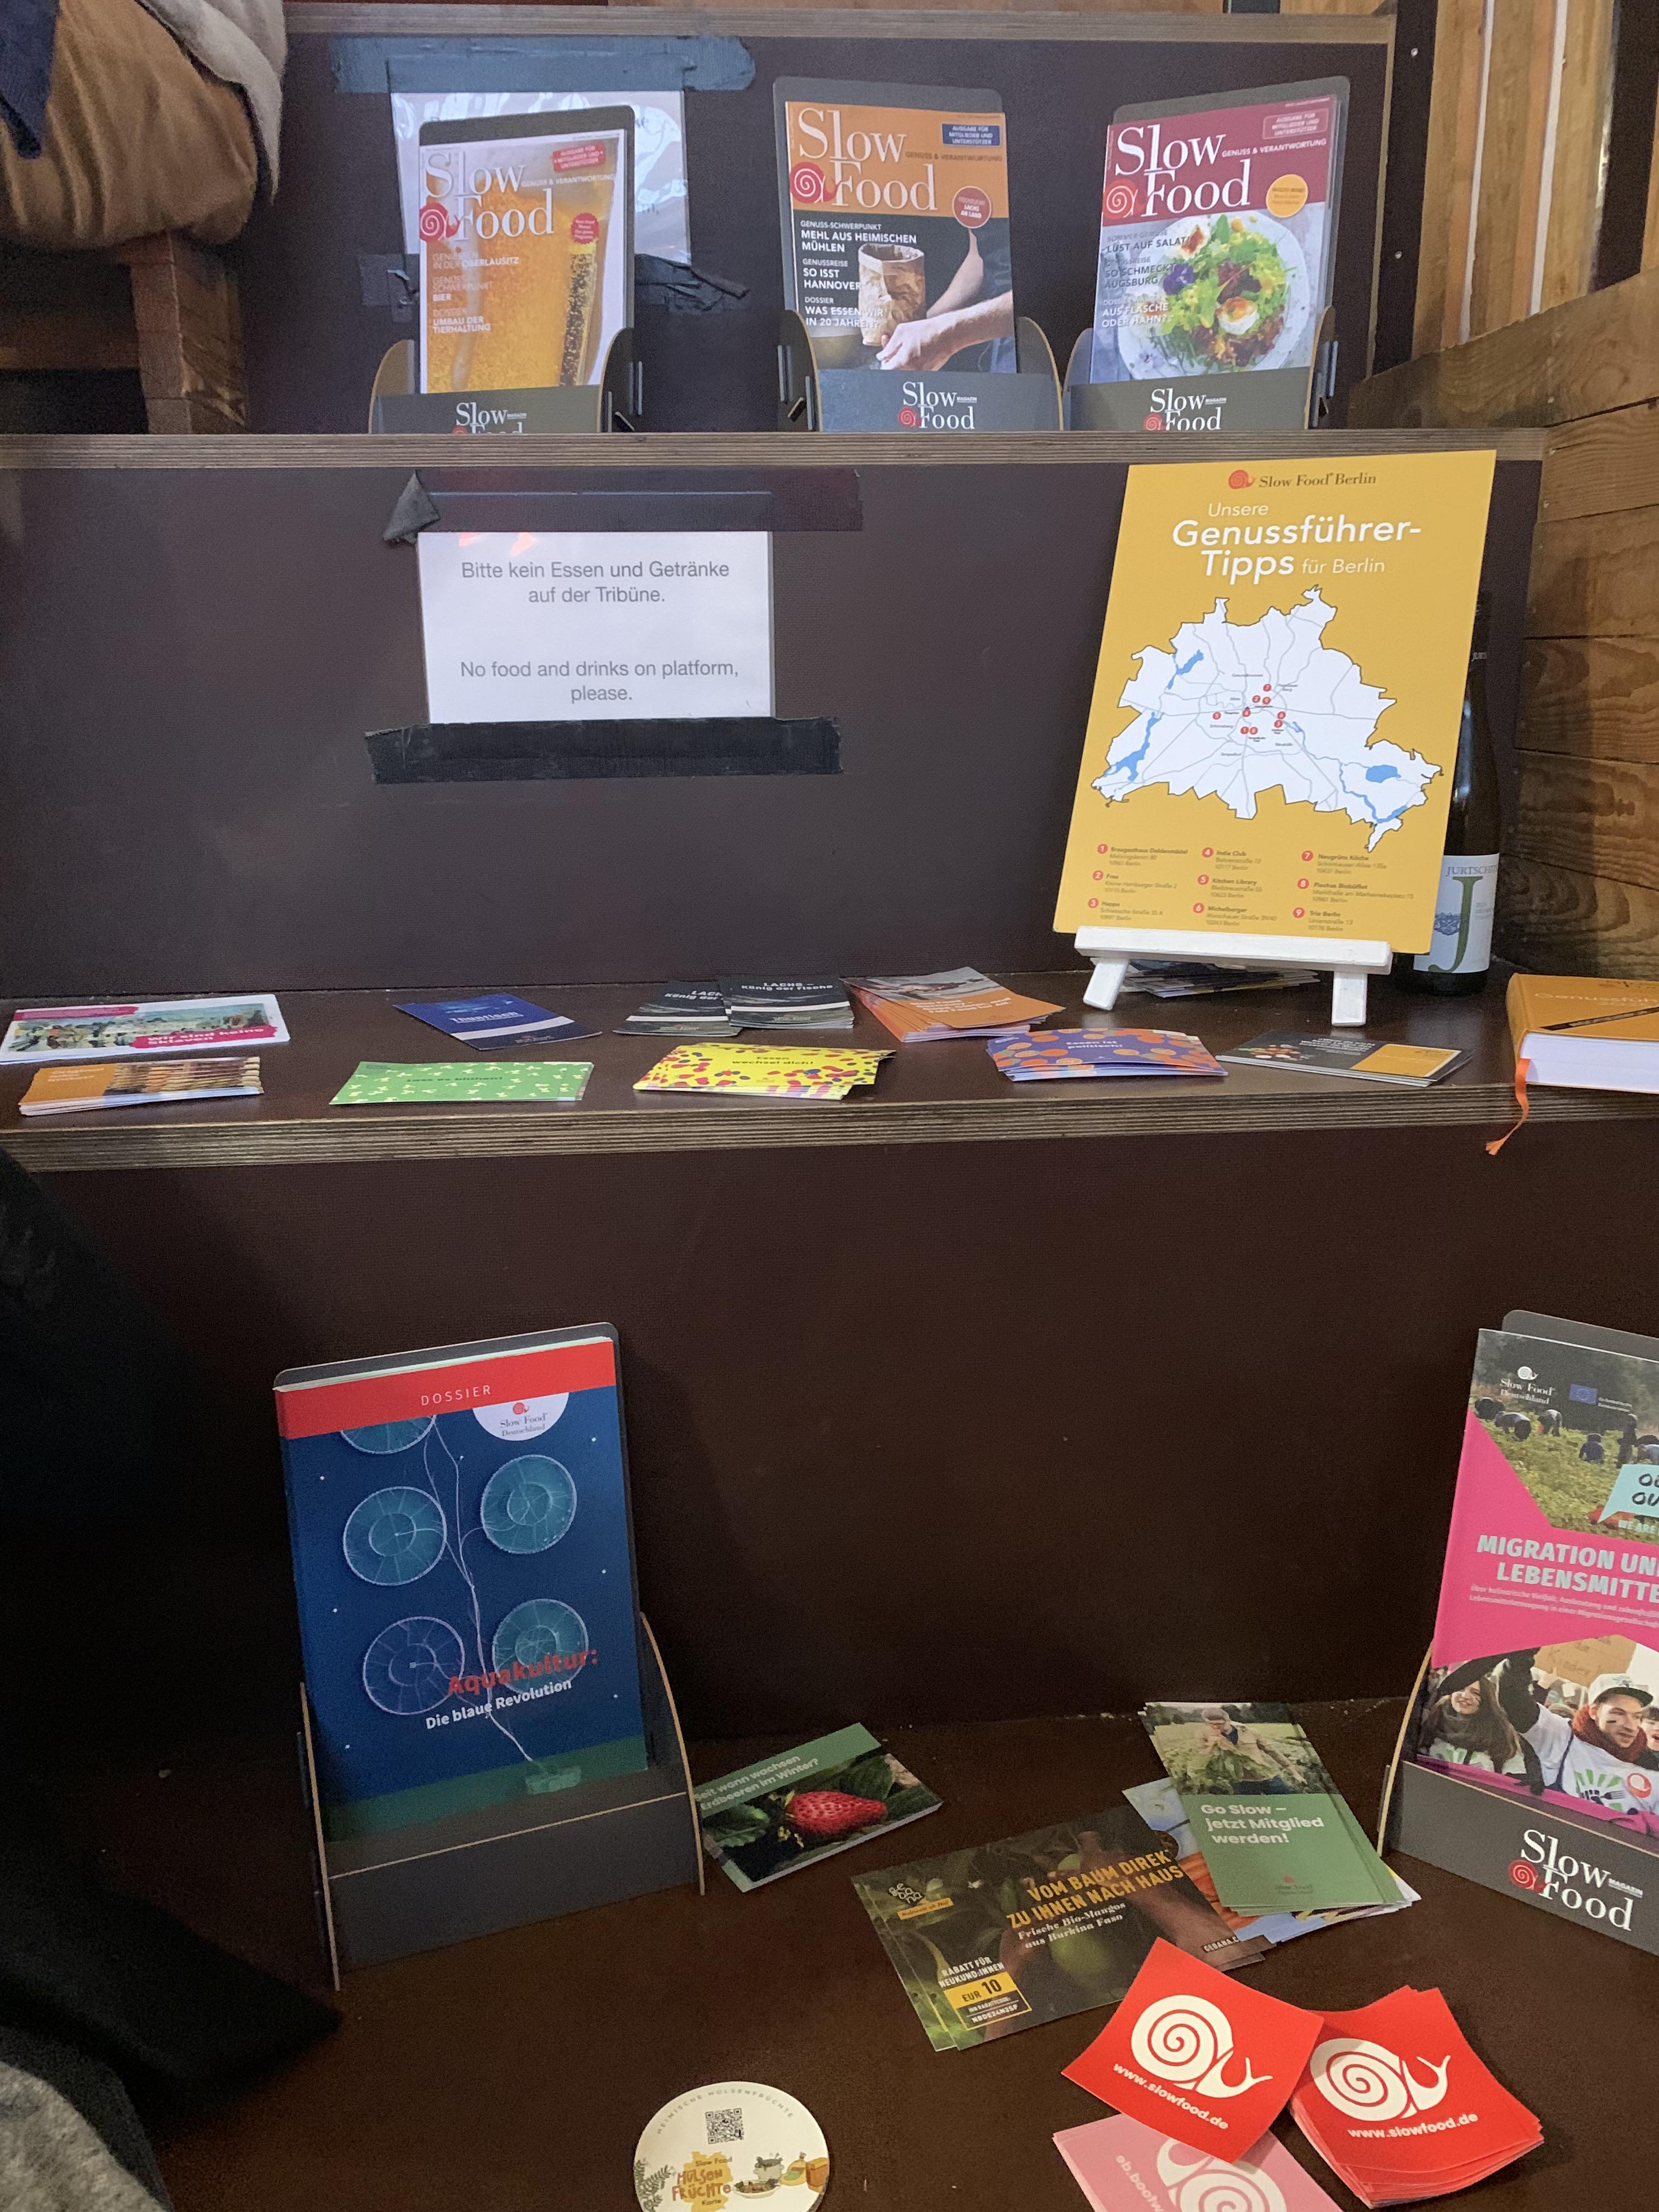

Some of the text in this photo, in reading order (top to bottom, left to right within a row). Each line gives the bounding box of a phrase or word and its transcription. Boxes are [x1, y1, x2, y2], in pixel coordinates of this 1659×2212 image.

[799, 108, 907, 163] Slow
[1114, 124, 1227, 176] Slow
[1221, 147, 1251, 158] GENUSS
[1259, 138, 1328, 154] VERANTWORTUNG
[425, 150, 526, 198] Slow
[830, 160, 938, 211] Food
[1140, 158, 1252, 217] Food
[455, 188, 555, 241] Food
[800, 220, 882, 231] GENUSS-SCHWERPUNKT
[801, 229, 917, 244] MEHL AUS HEIMISCHEN
[802, 240, 845, 253] MÜHLEN
[1107, 240, 1153, 253] LUST AUF
[802, 258, 849, 268] GENUSSREISE
[803, 267, 840, 279] SO ISST
[803, 279, 861, 291] HANNOVER
[1104, 276, 1159, 289] AUGSBURG
[432, 293, 452, 301] BIER
[804, 296, 834, 304] DOSSIER
[433, 315, 484, 326] UMBAU DER
[804, 306, 828, 315] WAS
[830, 307, 862, 317] ESSEN
[805, 317, 817, 326] IN
[820, 317, 832, 327] 20
[1102, 308, 1123, 318] AUS
[432, 323, 492, 334] TIERHALTUNG
[1102, 318, 1130, 328] ODER
[902, 381, 959, 407] Slow
[1150, 388, 1207, 413] Slow
[456, 402, 509, 426] Slow
[917, 406, 975, 430] Food
[1164, 407, 1222, 431] Food
[1258, 476, 1293, 488] Slow
[1335, 472, 1376, 485] Berlin
[1208, 502, 1269, 517] Unsere
[1172, 514, 1422, 548] Genussführer-
[461, 560, 730, 578] Bitte kein Essen und Getränke
[1200, 550, 1385, 585] Tipps für Berlin
[528, 585, 665, 603] auf der Tribüne.
[460, 660, 739, 680] No food and drinks on platform,
[571, 686, 633, 704] please.
[420, 1384, 492, 1406] DOSSIER
[1499, 1378, 1523, 1391] Slow
[500, 1413, 546, 1428] Slow Food
[1476, 1534, 1615, 1570] MIGRATION
[425, 1679, 573, 1729] Die blaue Revolution
[699, 1757, 820, 1810] Erdbeeren im Winter?
[718, 1755, 802, 1792] wann wachsen
[1200, 1804, 1271, 1814] Go Slow
[1206, 1816, 1325, 1832] jetzt Mitglied
[1211, 1833, 1290, 1844] werden!
[1521, 1829, 1611, 1889] Slow
[1026, 1849, 1172, 1903] VOM BAUM DIREK
[1006, 1911, 1032, 1929] ZU
[1033, 1896, 1086, 1922] IHNEN
[1087, 1879, 1137, 1908] NACH
[1538, 1865, 1634, 1932] Food
[1017, 1901, 1126, 1940] Frische Bio-Mangos
[1025, 1913, 1124, 1950] aus Burkina Faso
[941, 1956, 992, 1977] RABATT FÜR
[961, 1979, 1002, 2002] EUR 10
[1113, 2062, 1229, 2131] www.slowfood.de
[1347, 2111, 1479, 2141] www.slowfood.de
